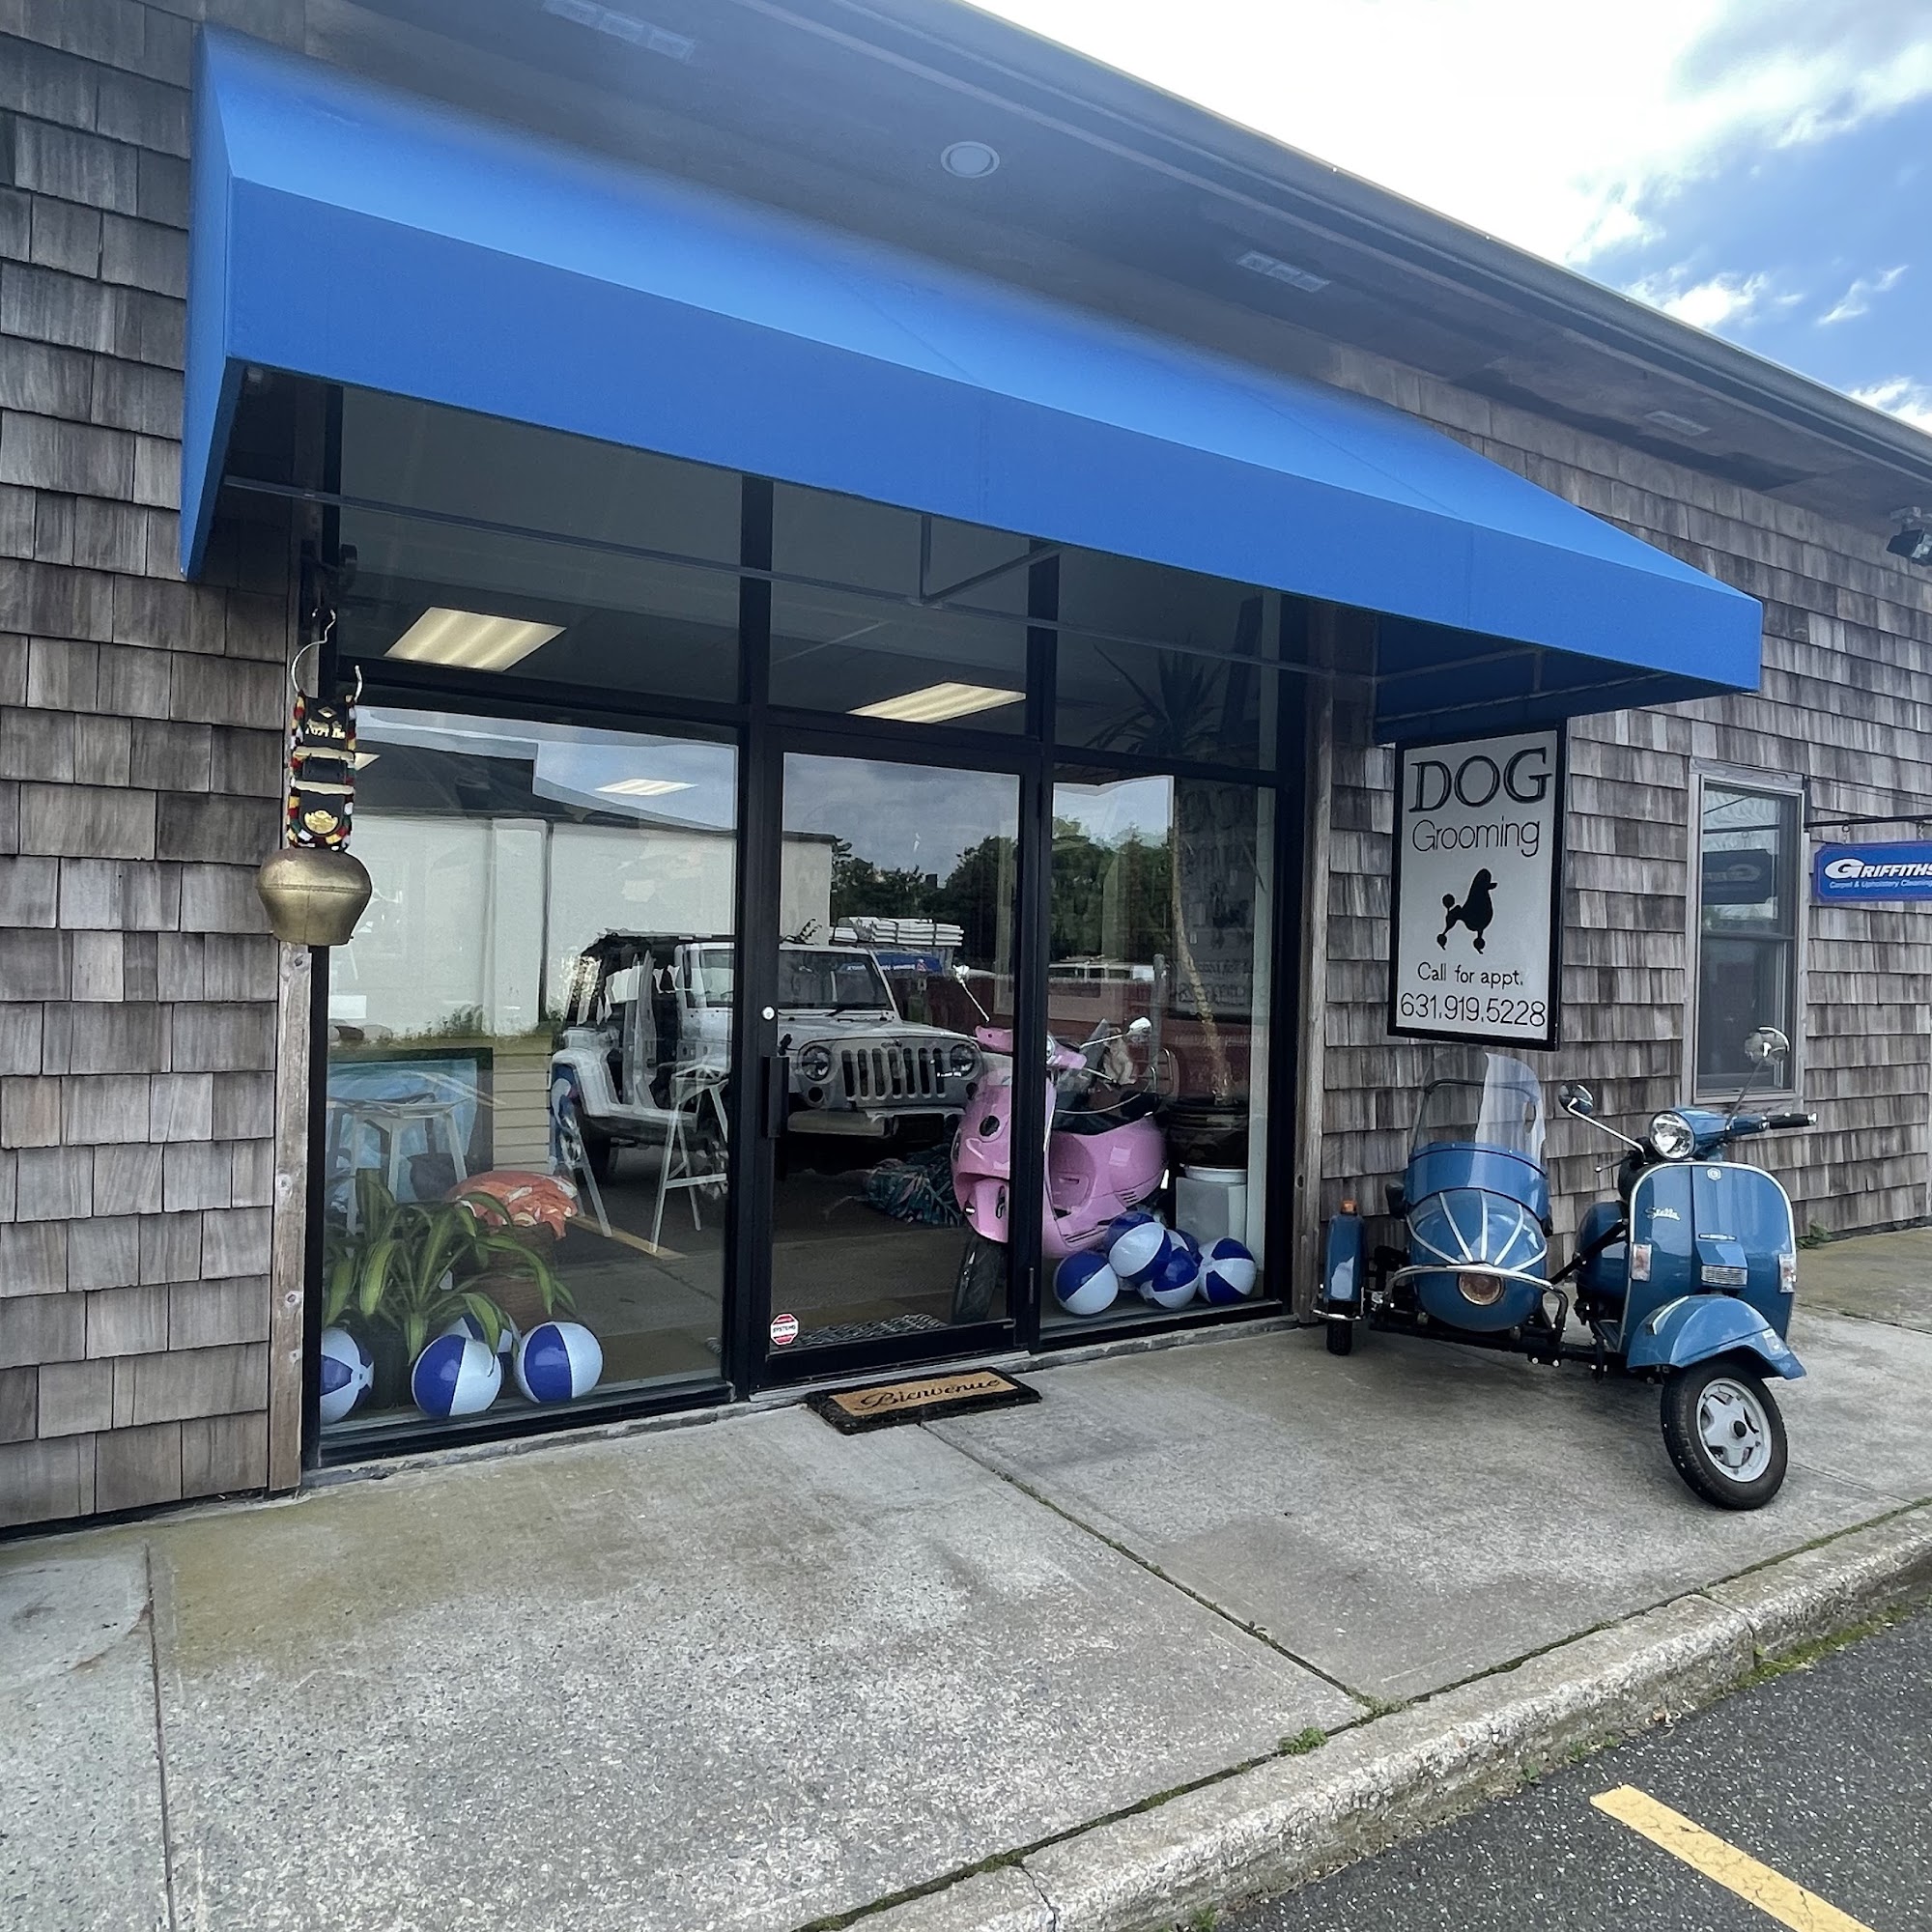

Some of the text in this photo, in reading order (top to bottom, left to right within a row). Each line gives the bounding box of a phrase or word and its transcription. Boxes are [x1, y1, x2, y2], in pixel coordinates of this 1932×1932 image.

[1408, 747, 1551, 813] DOG
[1412, 816, 1540, 858] Grooming
[1417, 961, 1523, 990] Call for appt.
[1401, 992, 1546, 1027] 631.919.5228
[854, 1378, 1001, 1411] Bienvenue
